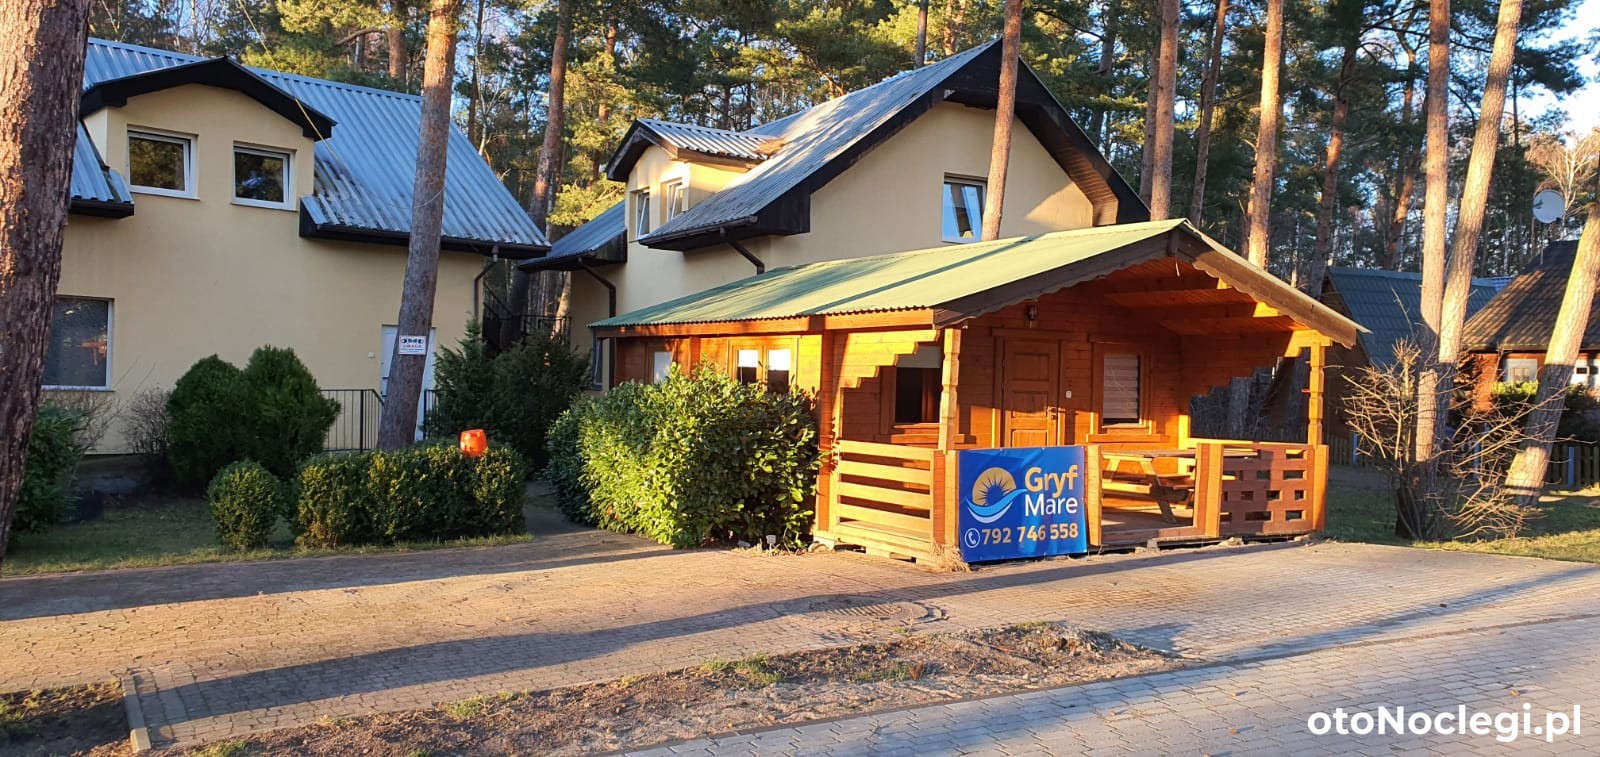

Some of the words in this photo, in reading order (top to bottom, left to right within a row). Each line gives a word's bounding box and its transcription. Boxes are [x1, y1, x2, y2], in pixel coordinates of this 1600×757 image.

[1025, 465, 1078, 498] Gryf
[1025, 493, 1078, 516] Mare
[982, 527, 1012, 544] 792
[1017, 525, 1046, 542] 746
[1050, 522, 1079, 540] 558
